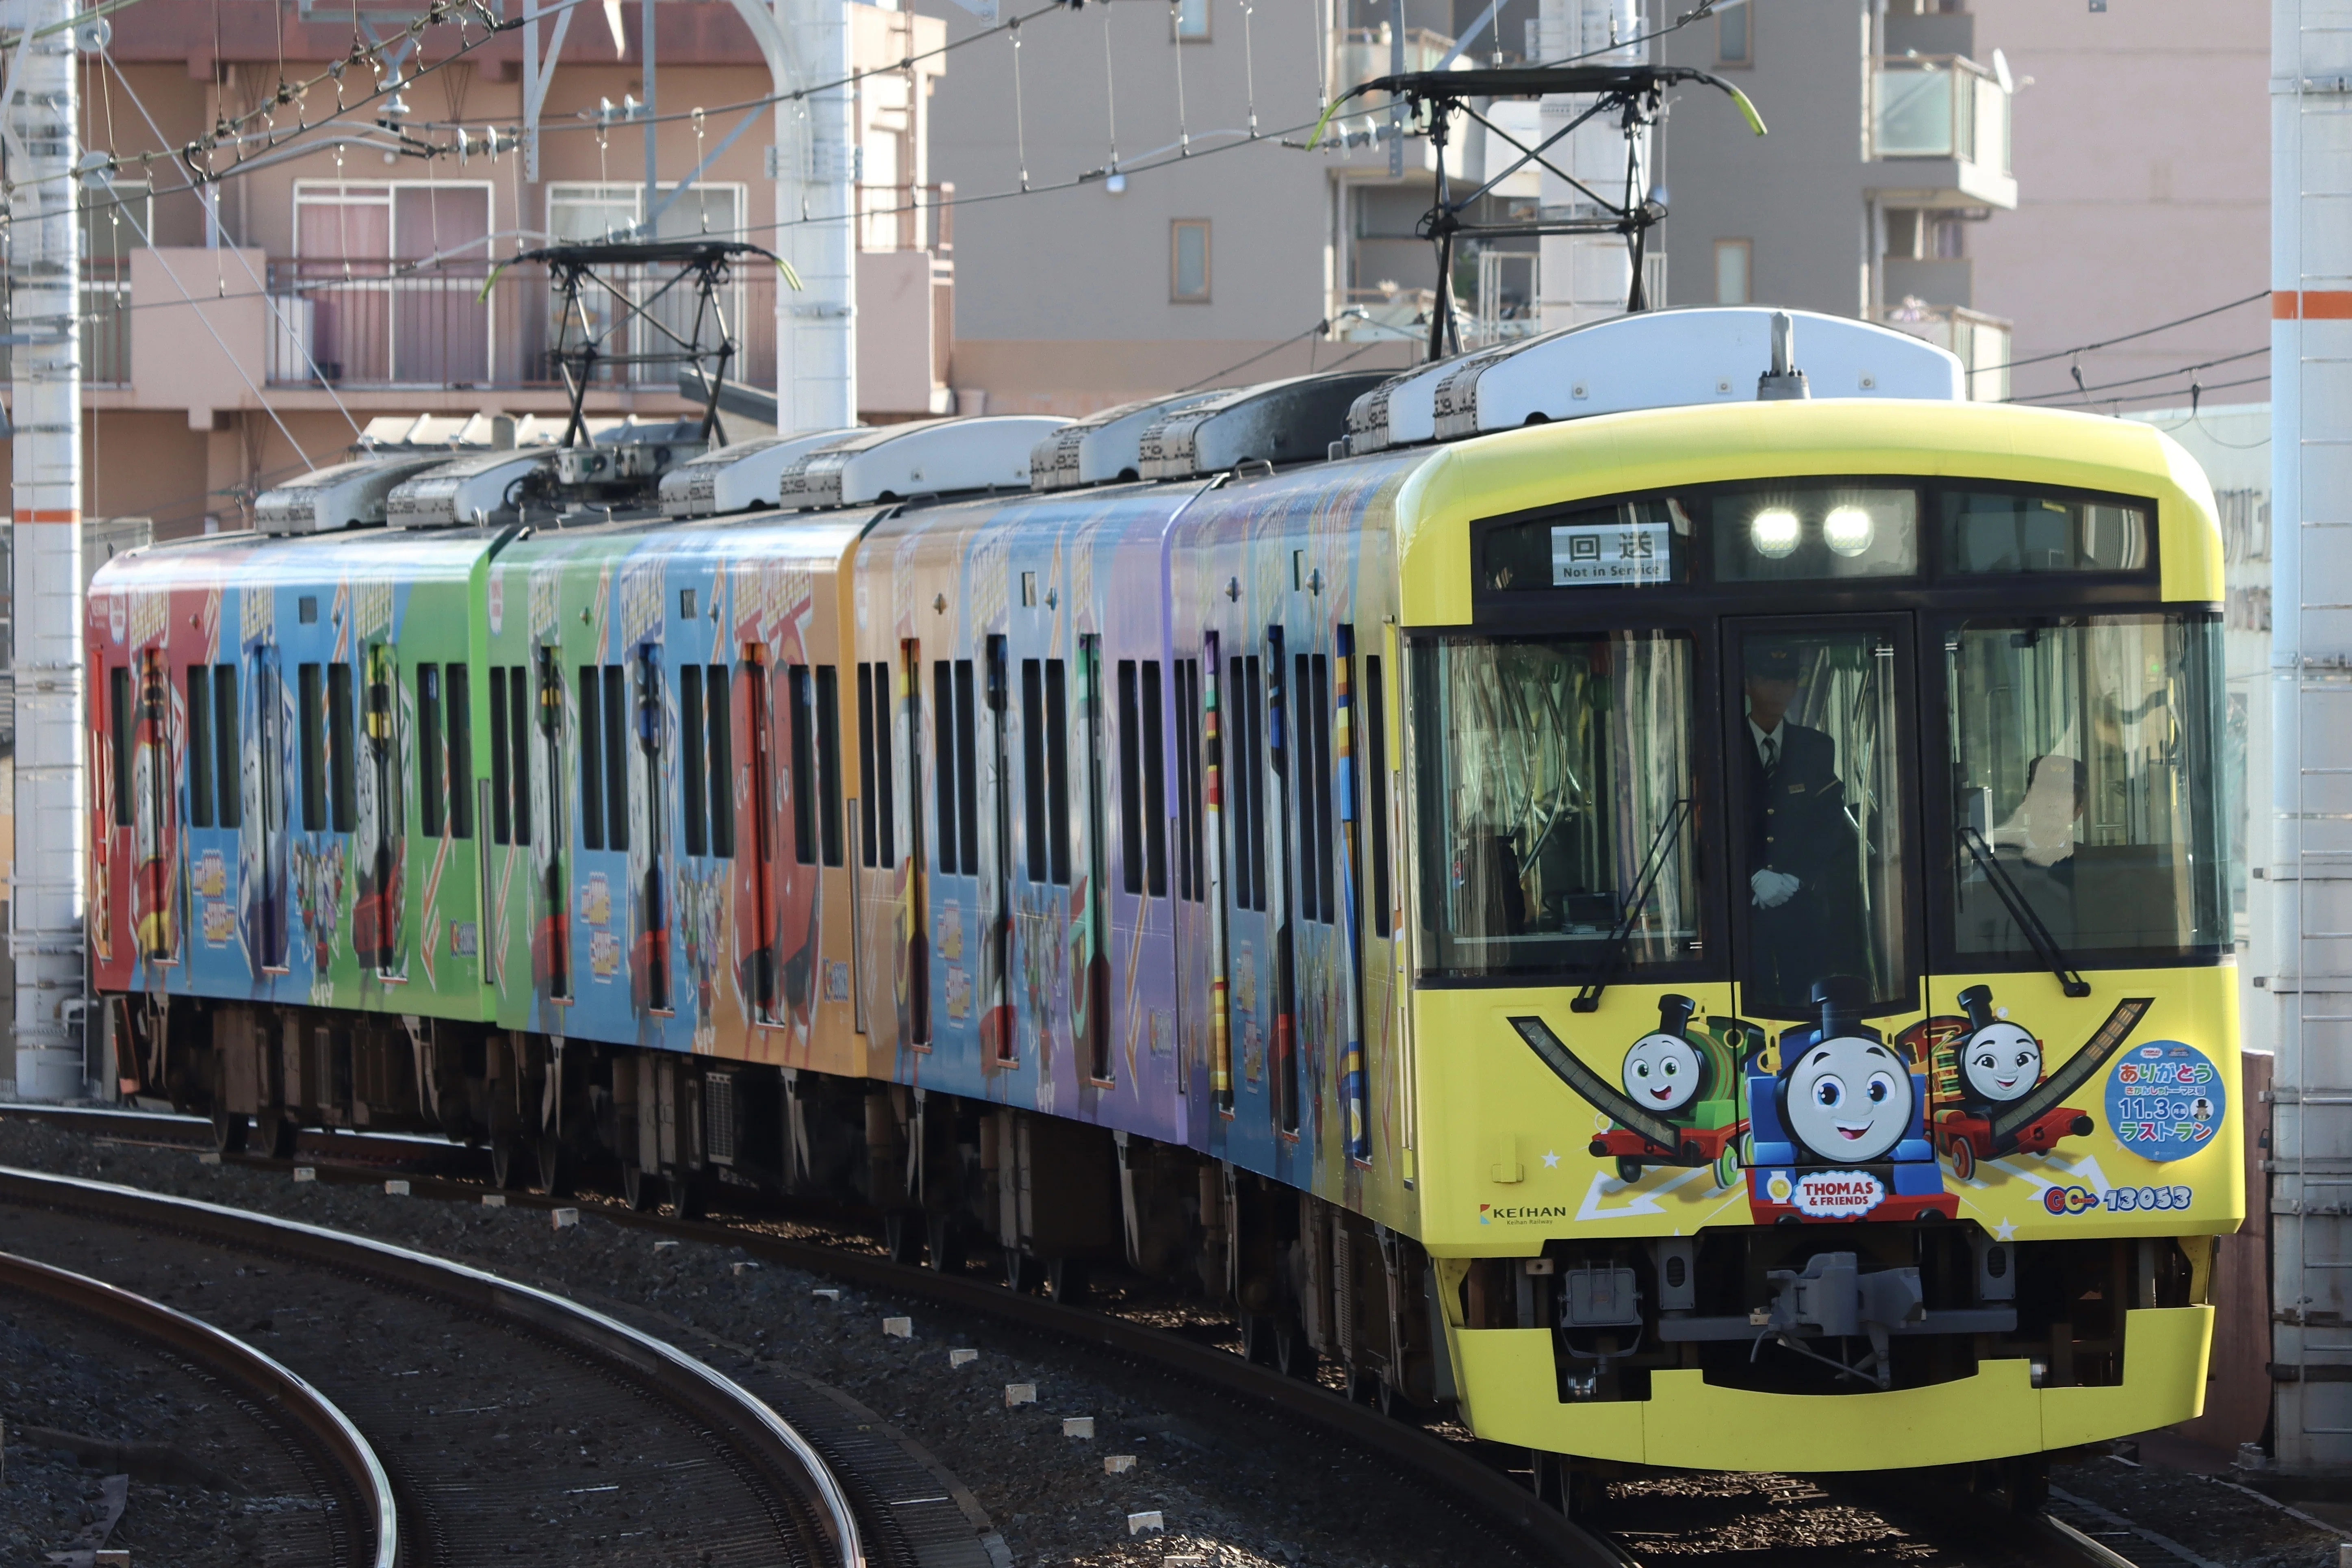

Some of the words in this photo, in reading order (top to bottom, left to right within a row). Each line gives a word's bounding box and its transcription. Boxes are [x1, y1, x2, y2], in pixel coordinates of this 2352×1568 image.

[1569, 531, 1653, 562] 回送
[1564, 568, 1588, 577] Not
[1593, 566, 1606, 576] in
[2119, 1063, 2212, 1084] ありがとう
[2119, 1098, 2170, 1119] 11.3
[2120, 1121, 2212, 1142] ラストラン
[1803, 1181, 1874, 1196] THOMAS
[2104, 1186, 2191, 1211] 13053
[1809, 1197, 1818, 1206] &
[1820, 1196, 1869, 1206] FRIENDS
[1493, 1206, 1566, 1218] KEIHAN
